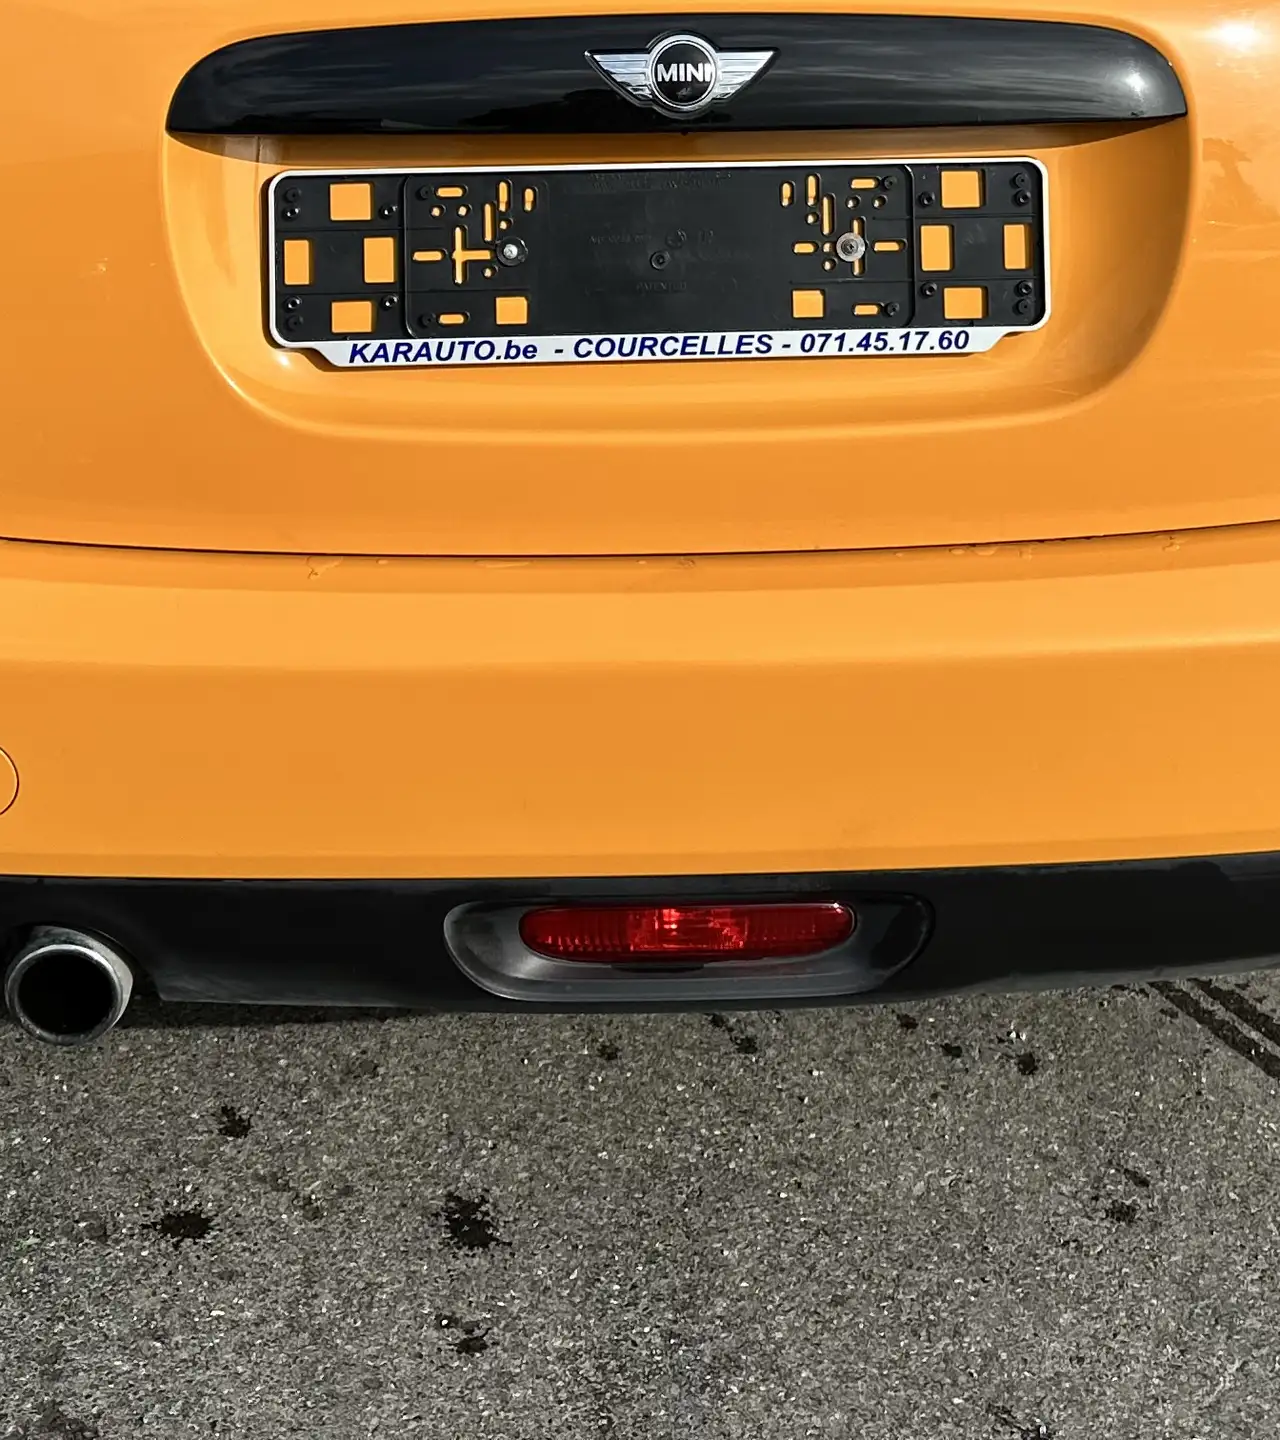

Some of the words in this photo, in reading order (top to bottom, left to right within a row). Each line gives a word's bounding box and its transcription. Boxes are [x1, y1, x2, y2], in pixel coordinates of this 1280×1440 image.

[657, 62, 713, 82] MINI
[349, 339, 538, 364] KARAUTO.be
[573, 334, 773, 359] COURCELLES
[800, 329, 970, 353] 071.45.17.60
